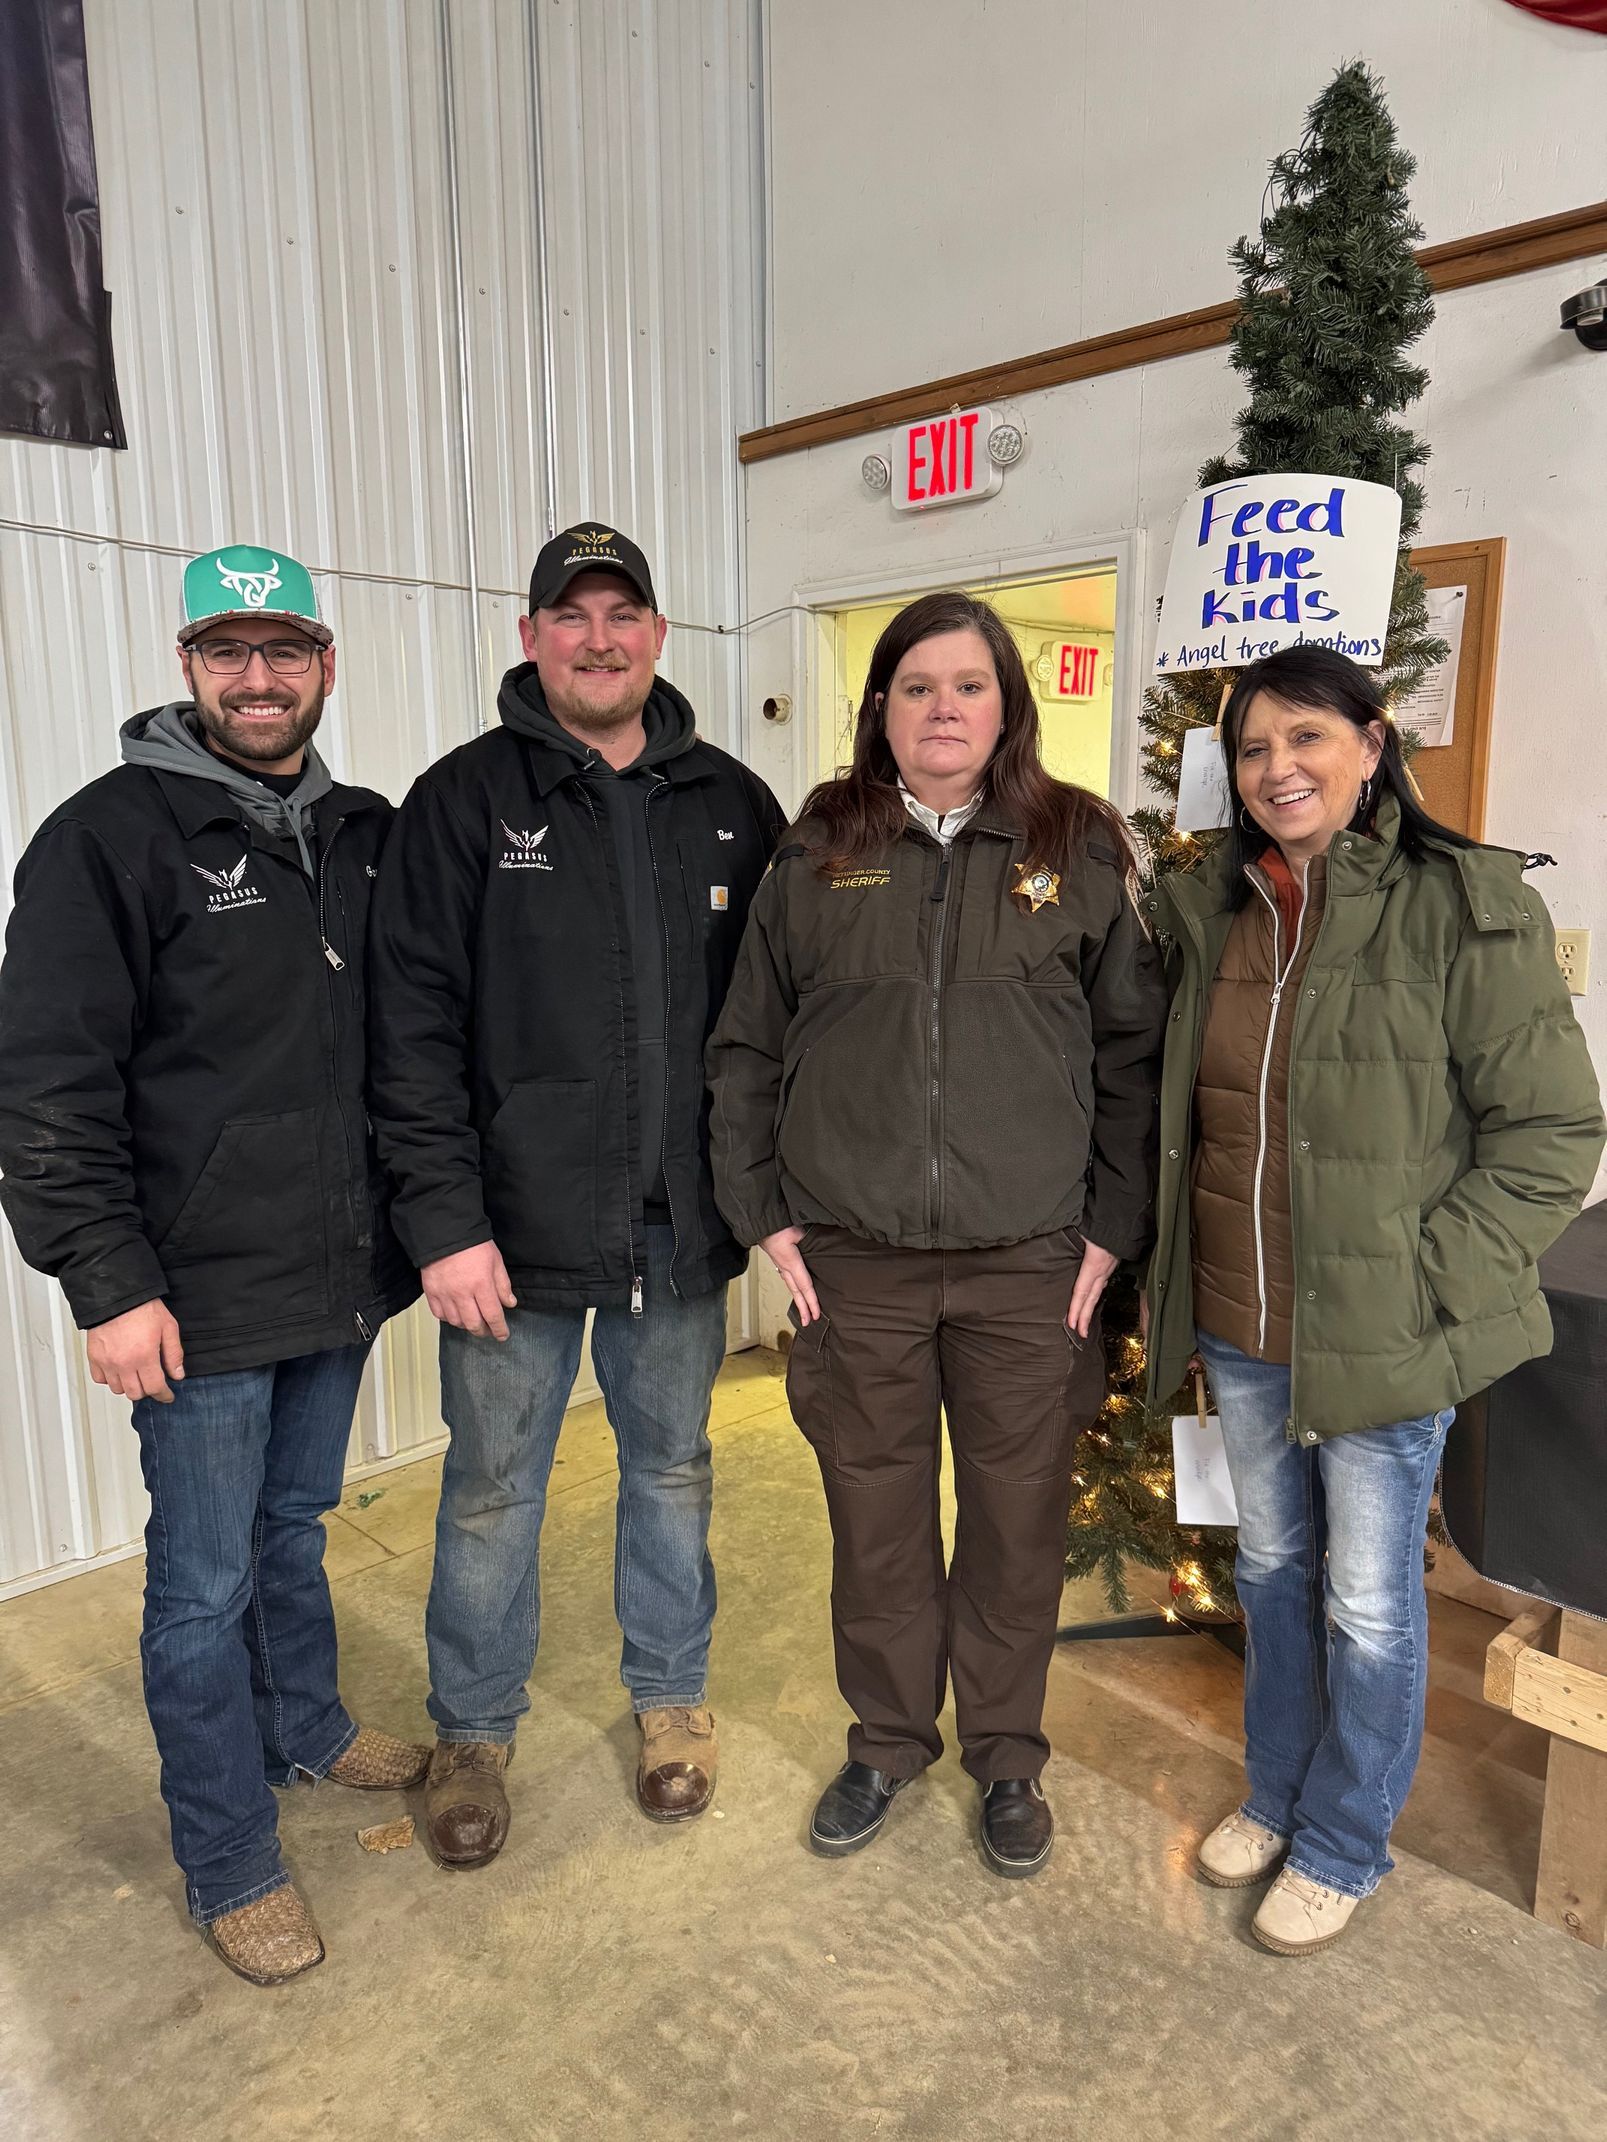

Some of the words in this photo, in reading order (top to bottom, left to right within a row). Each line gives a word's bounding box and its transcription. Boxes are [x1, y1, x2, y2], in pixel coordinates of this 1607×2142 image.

[908, 413, 979, 501] EXIT
[1198, 484, 1346, 547] Feed
[1212, 540, 1323, 586] the
[1176, 635, 1229, 668] Angel
[1236, 636, 1279, 659] tree
[1059, 644, 1099, 697] EXIT
[717, 829, 735, 841] Ben
[498, 859, 554, 871] Illuminations
[503, 851, 548, 863] PEGASUS
[830, 876, 891, 889] SHERIFF
[208, 886, 258, 904] PEGASUS
[206, 897, 267, 913] Illuminations
